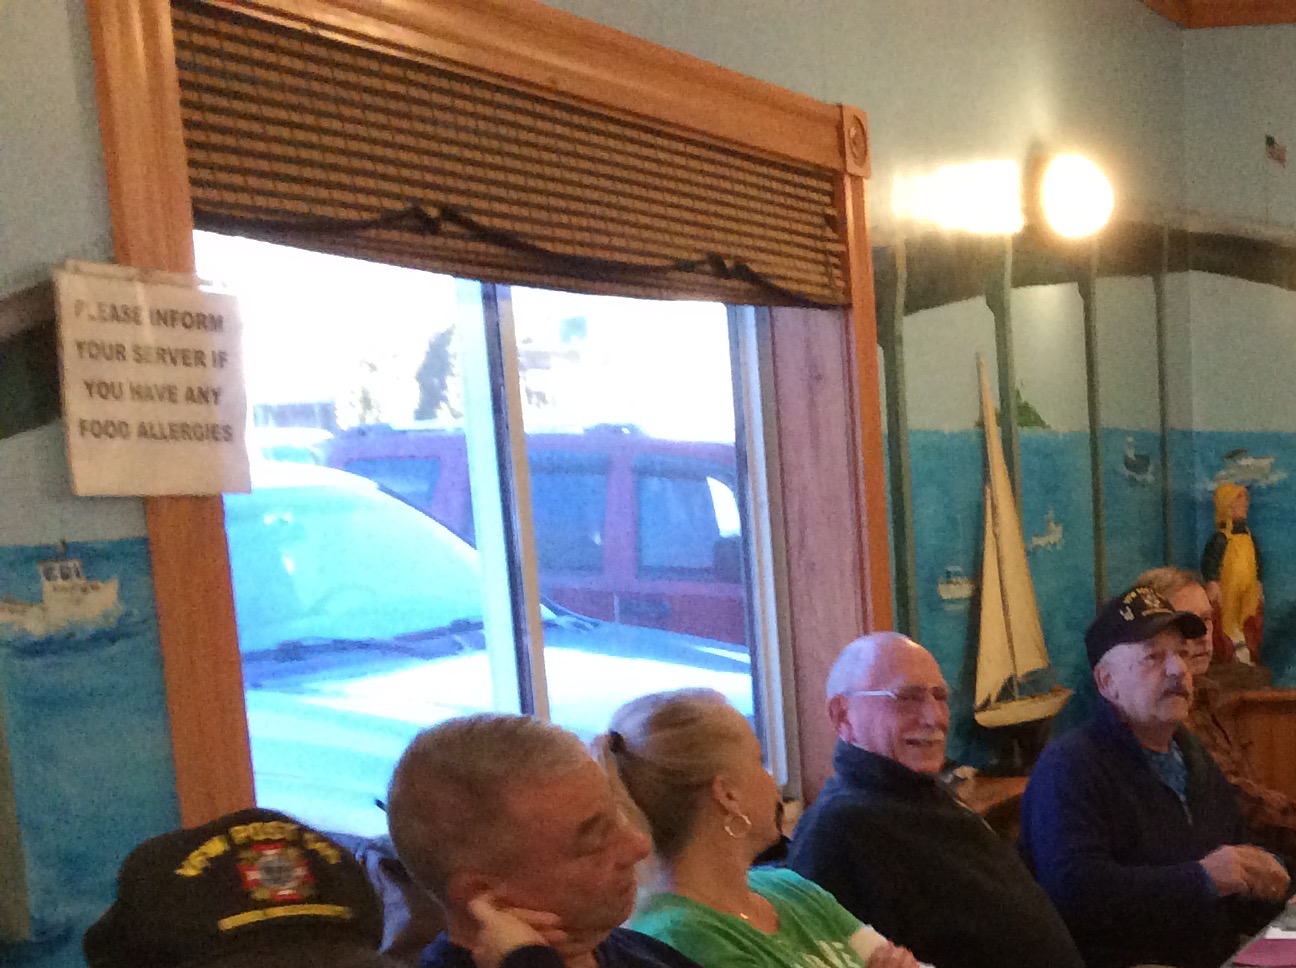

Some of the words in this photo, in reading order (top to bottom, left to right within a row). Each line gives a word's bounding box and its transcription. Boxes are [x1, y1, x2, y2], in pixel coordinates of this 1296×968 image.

[149, 308, 224, 332] INFORM
[76, 340, 127, 362] YOUR
[132, 344, 207, 368] SERVER
[211, 350, 229, 369] IF
[83, 379, 124, 400] YOU
[129, 382, 178, 404] HAVE
[184, 386, 222, 406] ANY
[78, 418, 130, 441] FOOD
[136, 422, 234, 443] ALLERGIES
